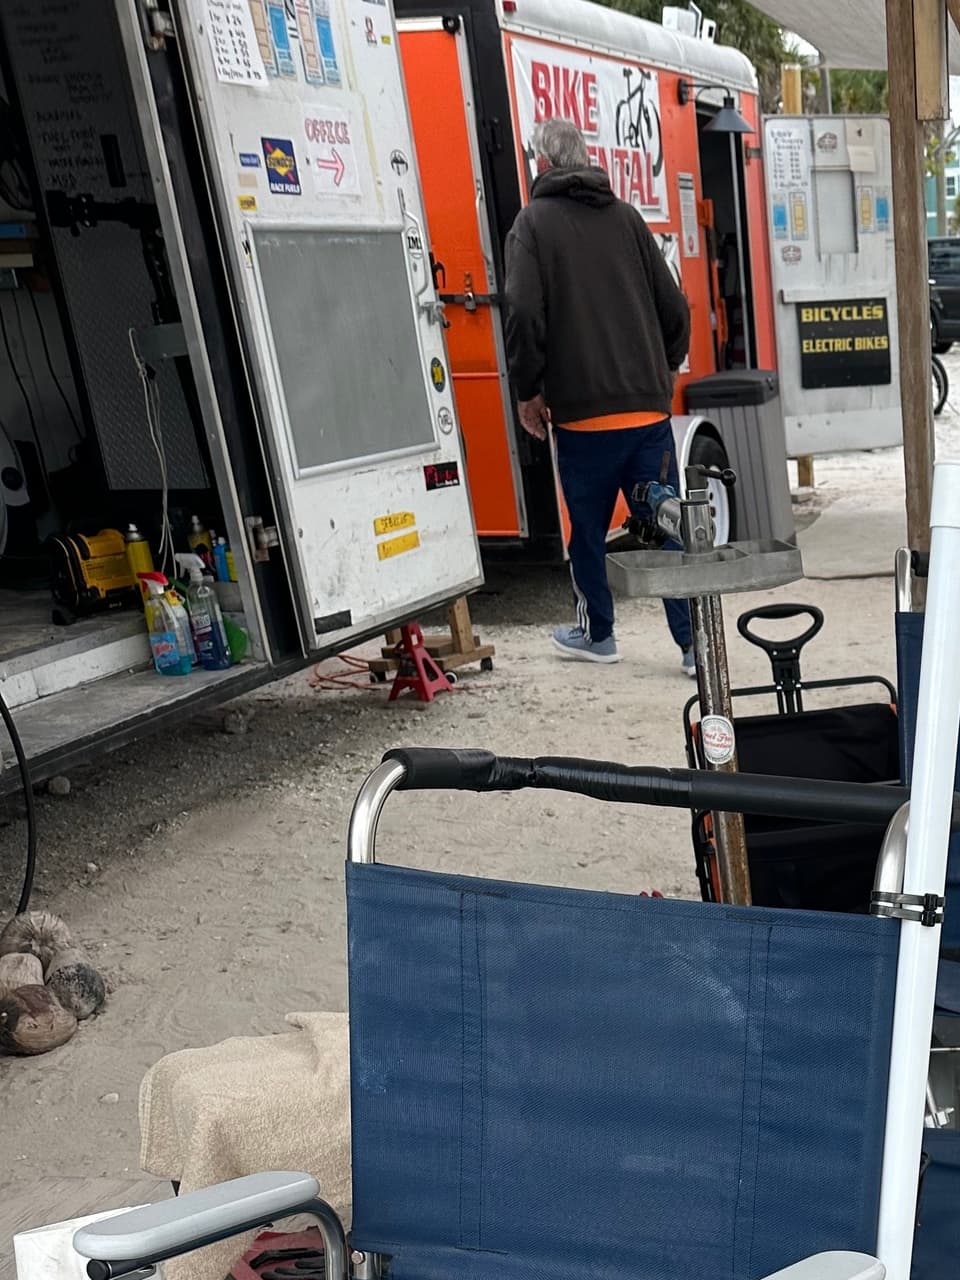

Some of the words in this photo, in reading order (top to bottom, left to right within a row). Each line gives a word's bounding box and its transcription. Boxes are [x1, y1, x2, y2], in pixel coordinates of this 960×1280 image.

[531, 60, 599, 134] BIKE
[304, 118, 351, 145] OFFICE
[267, 155, 294, 169] SUNOCO
[801, 305, 884, 323] BICYCLES
[802, 337, 853, 353] ELECTRIC
[853, 335, 889, 351] BIKES
